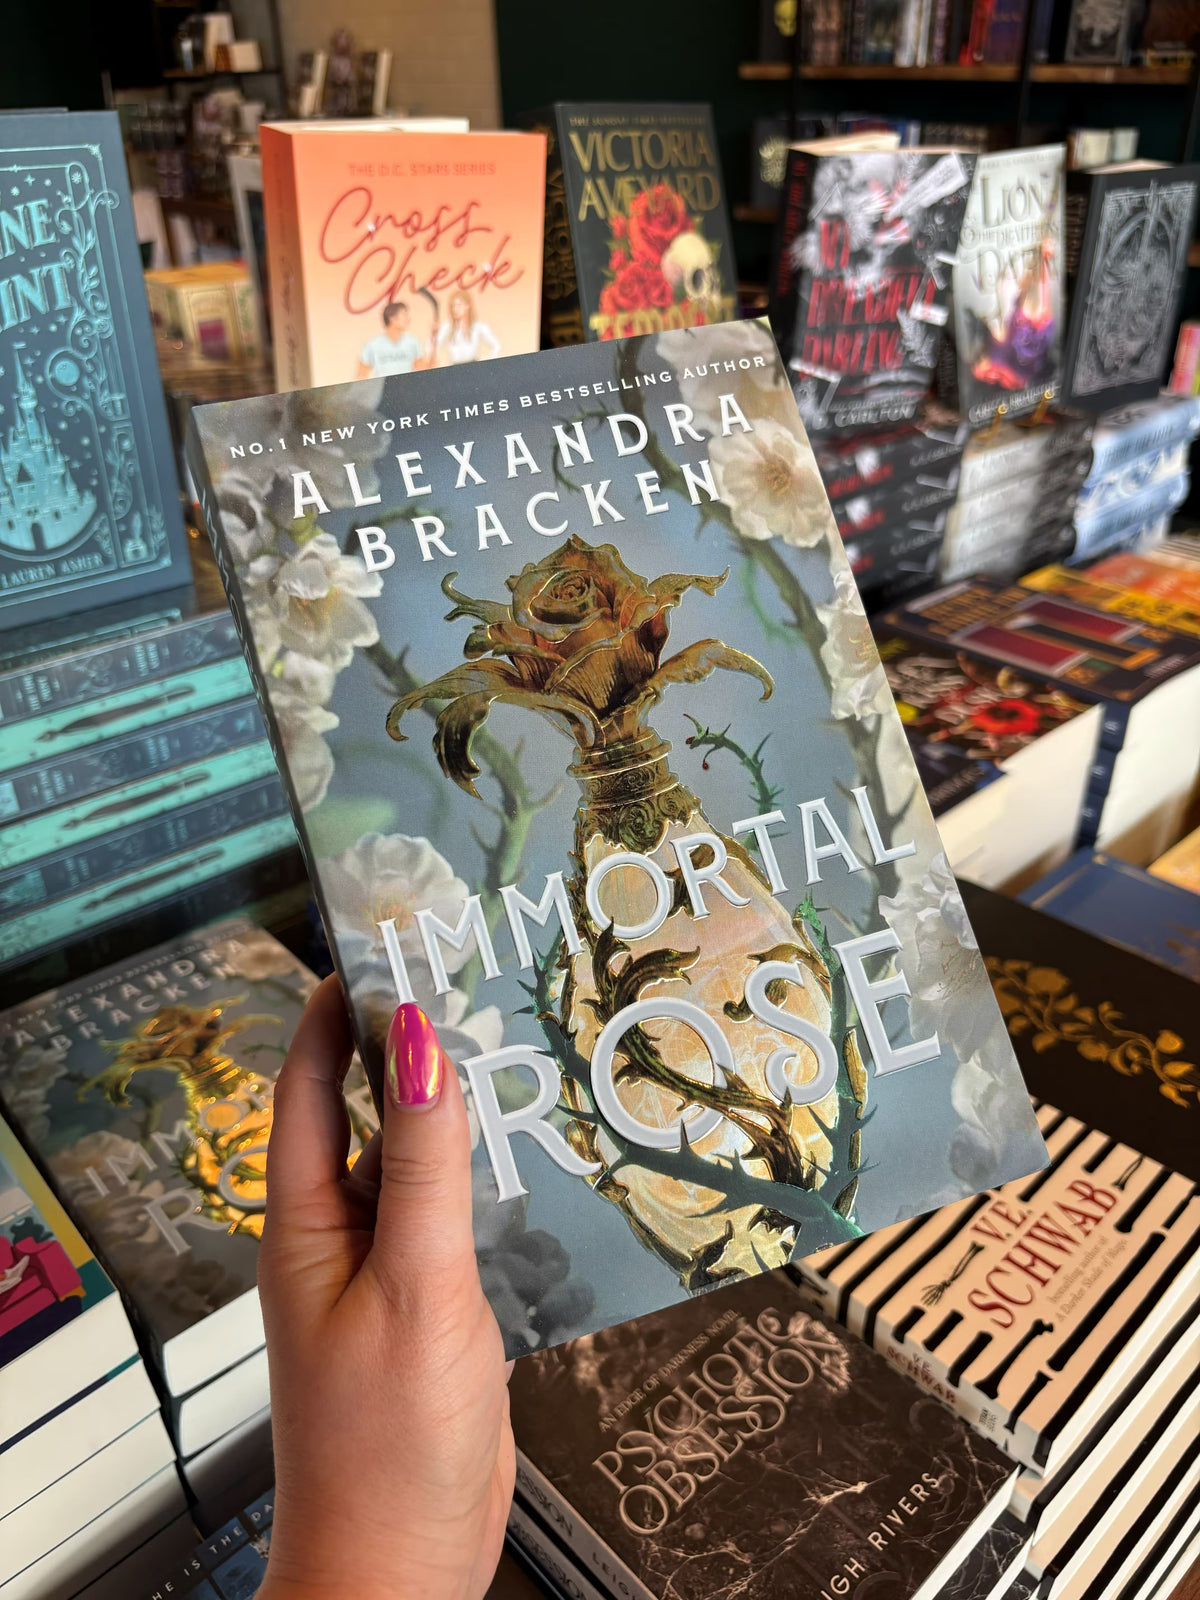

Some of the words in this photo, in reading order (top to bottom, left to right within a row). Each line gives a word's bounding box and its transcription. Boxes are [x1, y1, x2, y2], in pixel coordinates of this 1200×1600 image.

[348, 163, 375, 177] THE
[409, 163, 449, 177] STARS
[452, 162, 497, 177] SERIES
[568, 131, 715, 172] VICTORIA
[579, 172, 720, 222] AVEYARD
[320, 187, 493, 264] Cross
[343, 233, 525, 315] Check
[0, 262, 74, 334] INT
[229, 438, 287, 460] NO.1
[302, 425, 356, 447] NEW
[367, 412, 429, 435] YORK
[440, 399, 510, 422] TIMES
[519, 370, 673, 408] BESTSELLING
[683, 355, 766, 380] AUTHOR
[291, 393, 754, 520] ALEXANDRA
[355, 459, 721, 573] BRACKEN
[376, 785, 918, 1004] IMMORTAL
[14, 939, 247, 1049] ALEXANDRA
[51, 961, 237, 1052] BRACKEN
[458, 927, 942, 1205] ROSE
[967, 1178, 1119, 1330] SCHWAB
[971, 1199, 1033, 1242] V.E.
[592, 1306, 798, 1494] PSYCHOTIC
[599, 1412, 617, 1432] AN
[614, 1387, 647, 1417] EDGE
[642, 1373, 660, 1392] OF
[658, 1332, 711, 1377] DARKNESS
[704, 1309, 741, 1336] NOVEL
[619, 1313, 852, 1535] OBSESSION
[183, 1559, 201, 1577] IS
[209, 1526, 243, 1555] THE
[867, 1472, 940, 1551] RIVERS
